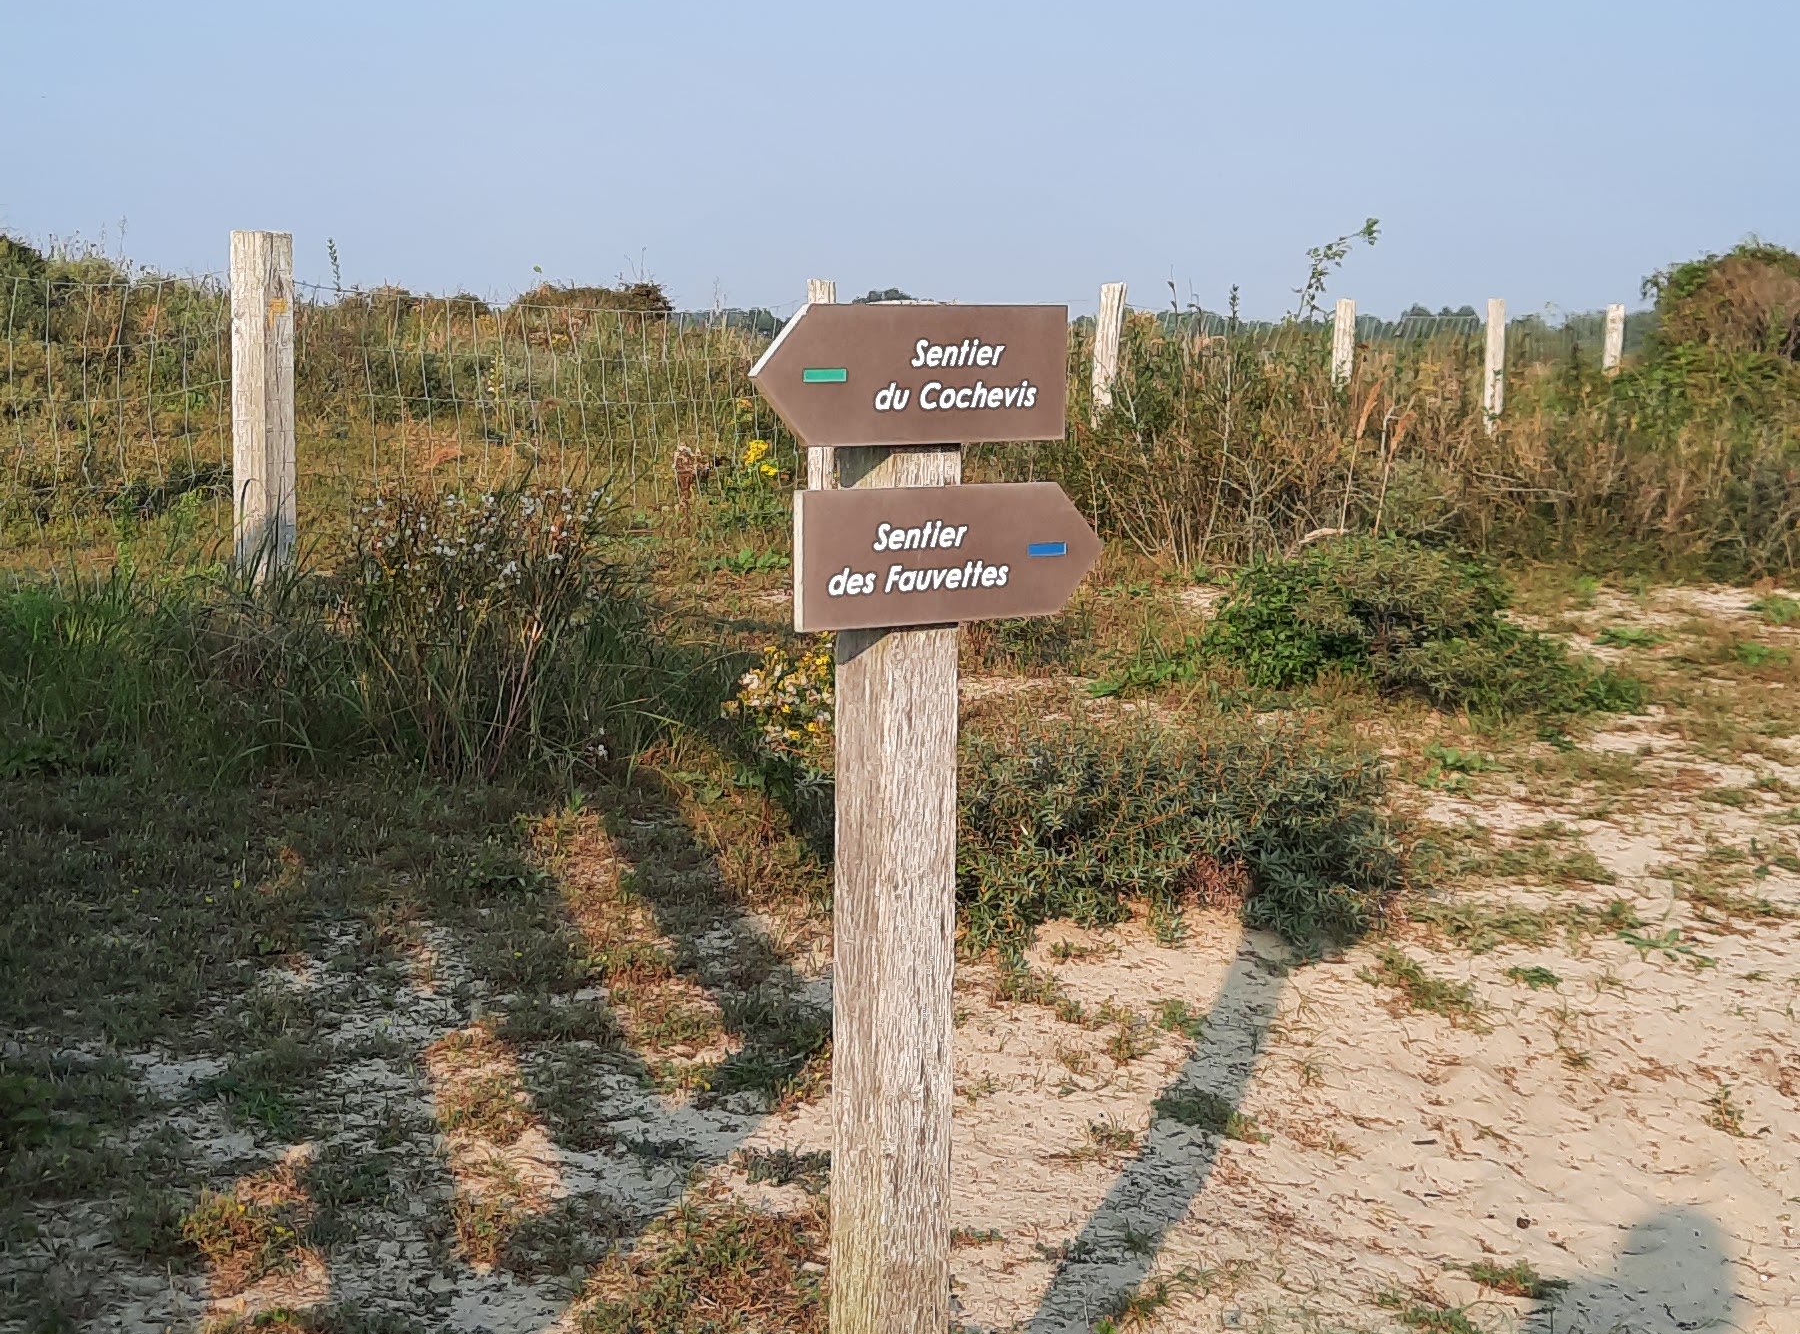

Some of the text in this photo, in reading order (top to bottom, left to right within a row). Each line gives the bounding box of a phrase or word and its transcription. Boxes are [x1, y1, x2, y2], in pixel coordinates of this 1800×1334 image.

[911, 338, 1005, 367] Sentier
[874, 380, 1037, 410] du Cochevis
[873, 520, 968, 550] Sentier
[828, 560, 1009, 595] des Fauvettes
